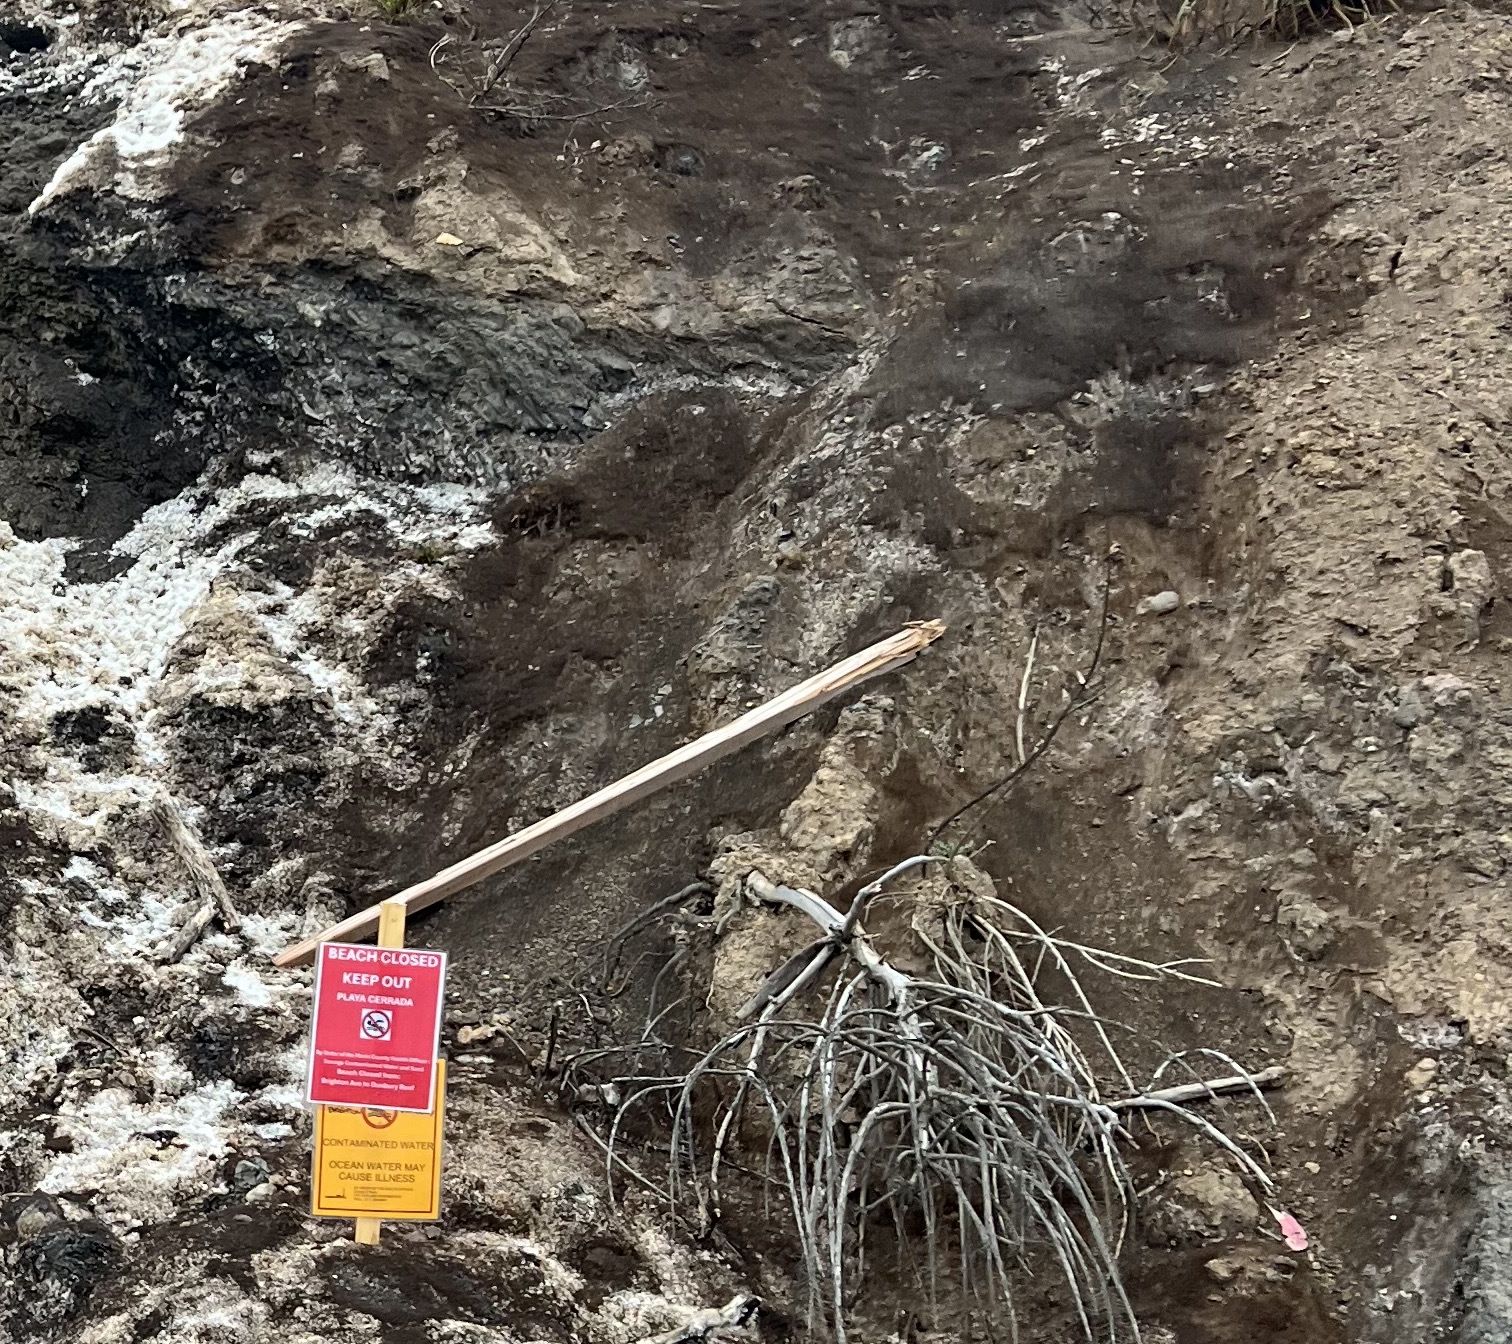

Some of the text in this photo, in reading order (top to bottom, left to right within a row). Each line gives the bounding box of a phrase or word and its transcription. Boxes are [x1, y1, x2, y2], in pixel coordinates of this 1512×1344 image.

[328, 947, 439, 968] BEACH CLOSED
[342, 972, 412, 989] KEEP OUT
[336, 992, 414, 1007] PLAYA CERRADA
[322, 1138, 435, 1151] CONTAMINATED WATER
[329, 1160, 426, 1172] OCEAN WATER MAY
[338, 1172, 416, 1183] CAUSE ILLNESS
